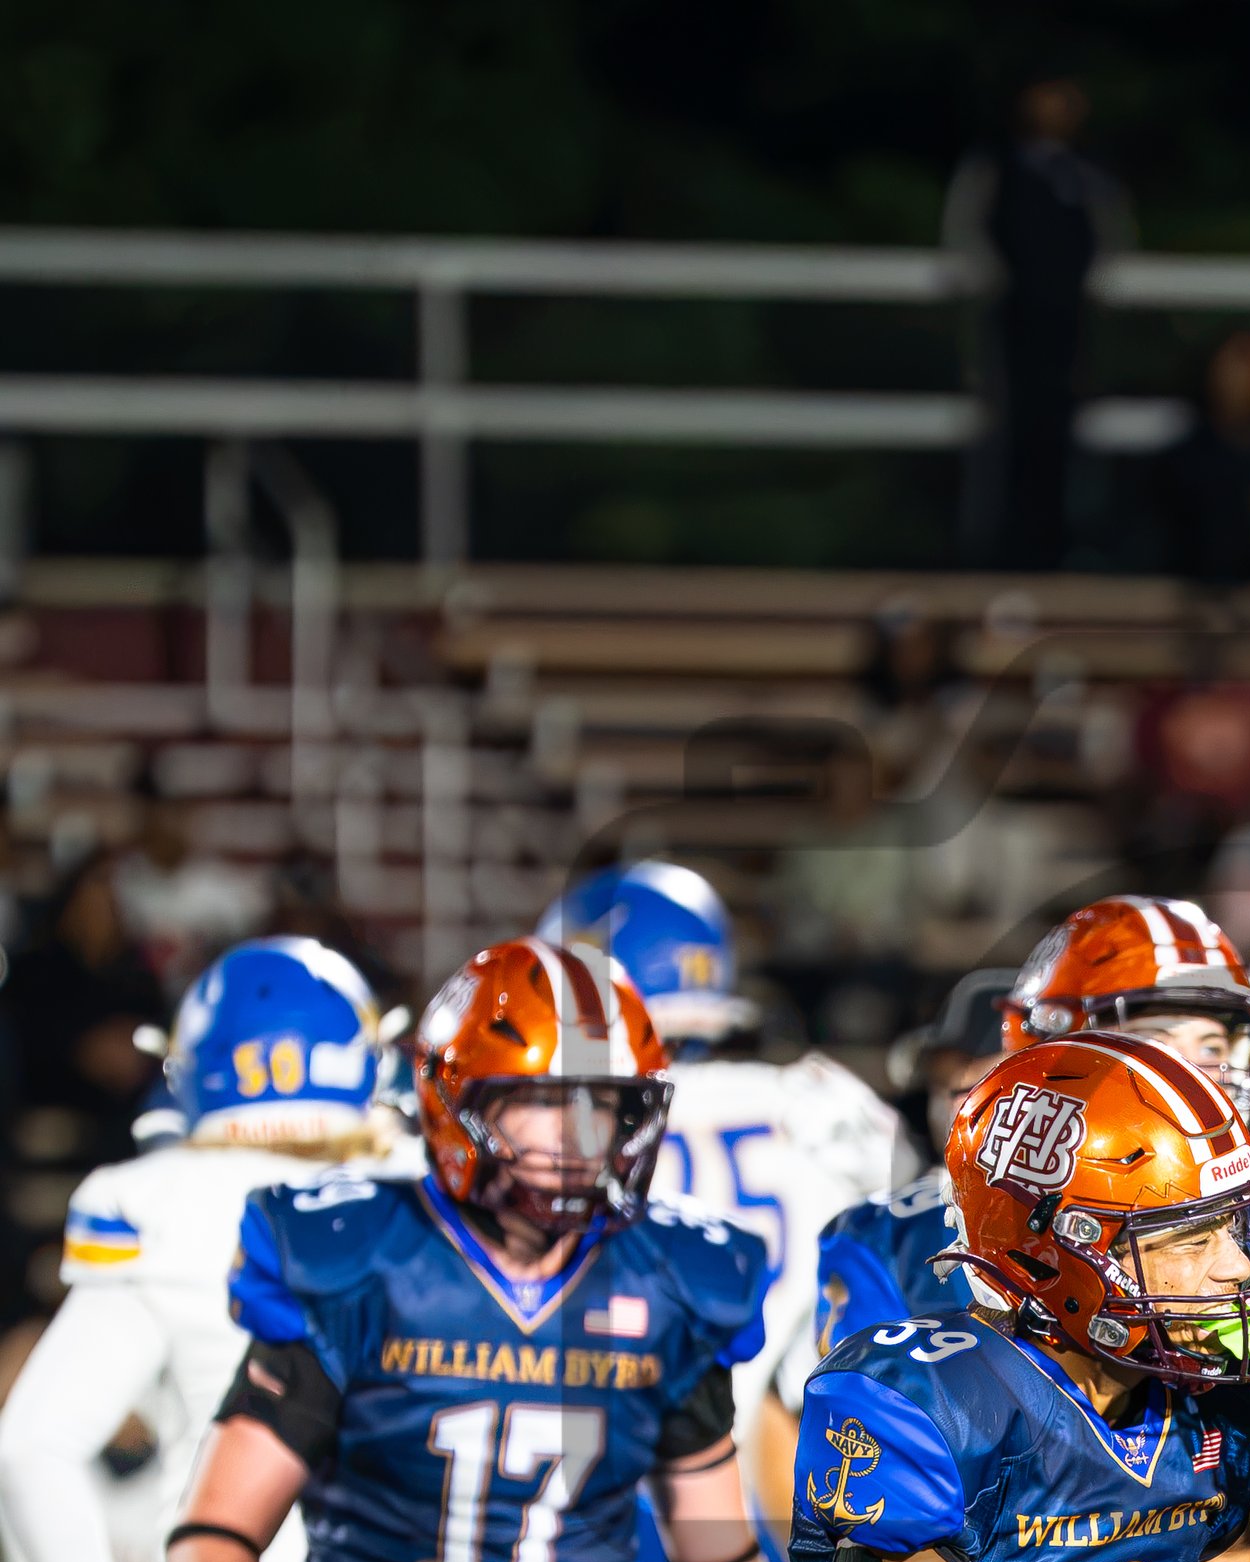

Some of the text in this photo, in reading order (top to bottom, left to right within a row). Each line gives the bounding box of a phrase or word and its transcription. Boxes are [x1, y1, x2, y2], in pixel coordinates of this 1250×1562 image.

[381, 1338, 558, 1386] WILLIAM
[830, 1433, 872, 1458] NAVY
[1016, 1506, 1173, 1548] WILLIAM
